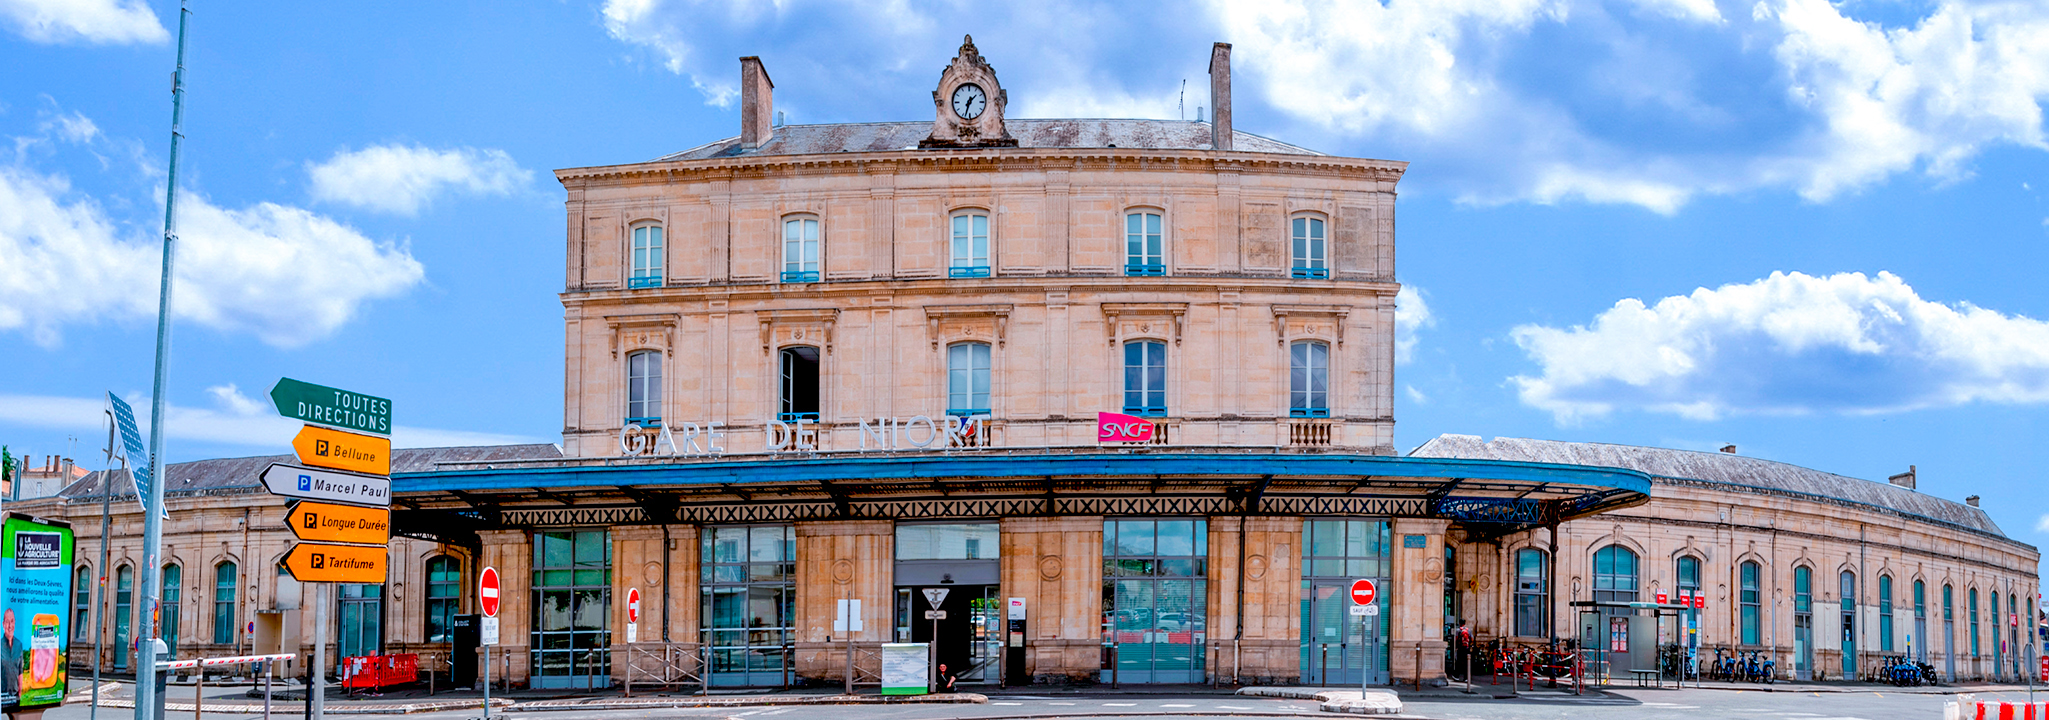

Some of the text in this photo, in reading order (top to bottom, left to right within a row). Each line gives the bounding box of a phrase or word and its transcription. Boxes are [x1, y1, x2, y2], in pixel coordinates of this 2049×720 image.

[334, 391, 387, 415] TOUTES
[298, 401, 387, 431] DIRECTIONS
[618, 414, 991, 455] GARE DE NIORT
[1100, 422, 1152, 438] SNCF
[334, 445, 375, 462] Bellune
[300, 477, 387, 498] P Marcel Paul
[322, 516, 356, 531] Longue
[359, 518, 387, 531] Durée
[24, 543, 52, 551] NOUVELLE
[24, 550, 59, 558] AGRICULTURE
[329, 557, 375, 569] Tartifume
[15, 577, 26, 585] dans
[18, 587, 43, 596] améliorons
[44, 588, 48, 596] la
[49, 589, 64, 598] qualité
[30, 596, 59, 605] alimentation.
